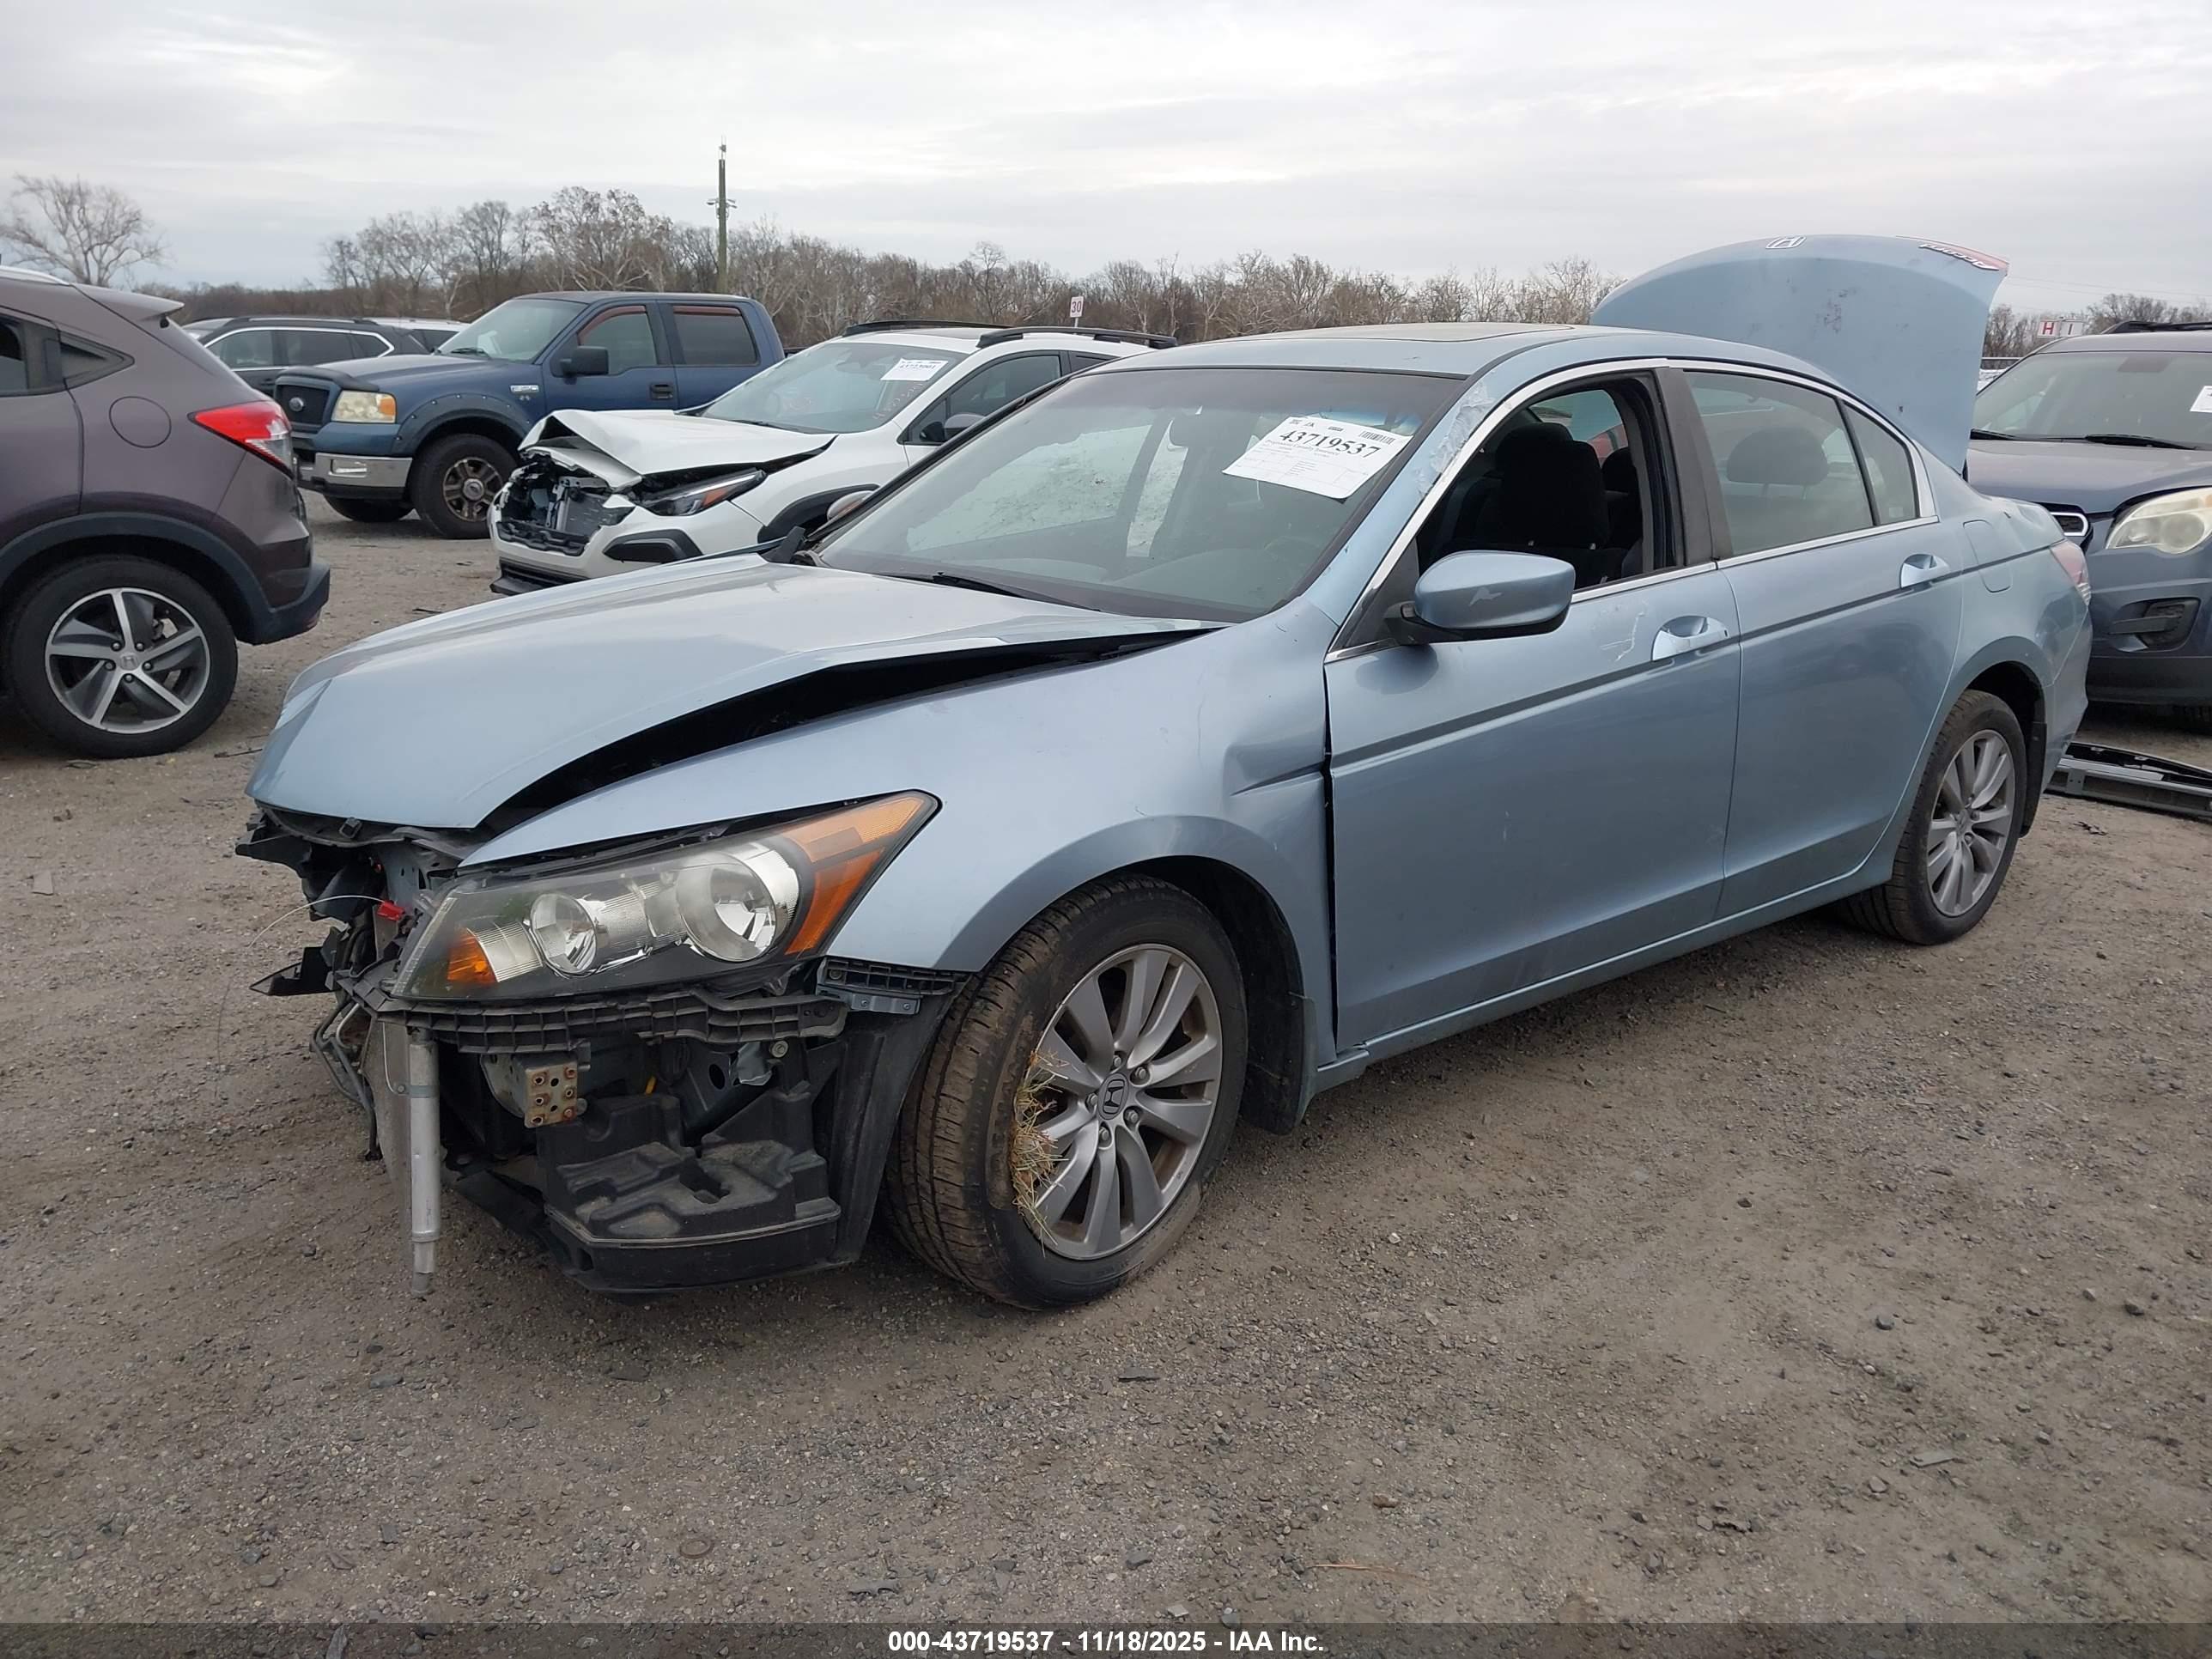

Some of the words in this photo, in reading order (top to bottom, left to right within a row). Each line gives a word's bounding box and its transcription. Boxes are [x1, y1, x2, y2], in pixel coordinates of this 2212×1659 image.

[1071, 301, 1082, 313] 30
[2042, 322, 2055, 335] H
[1279, 430, 1381, 459] 43719537
